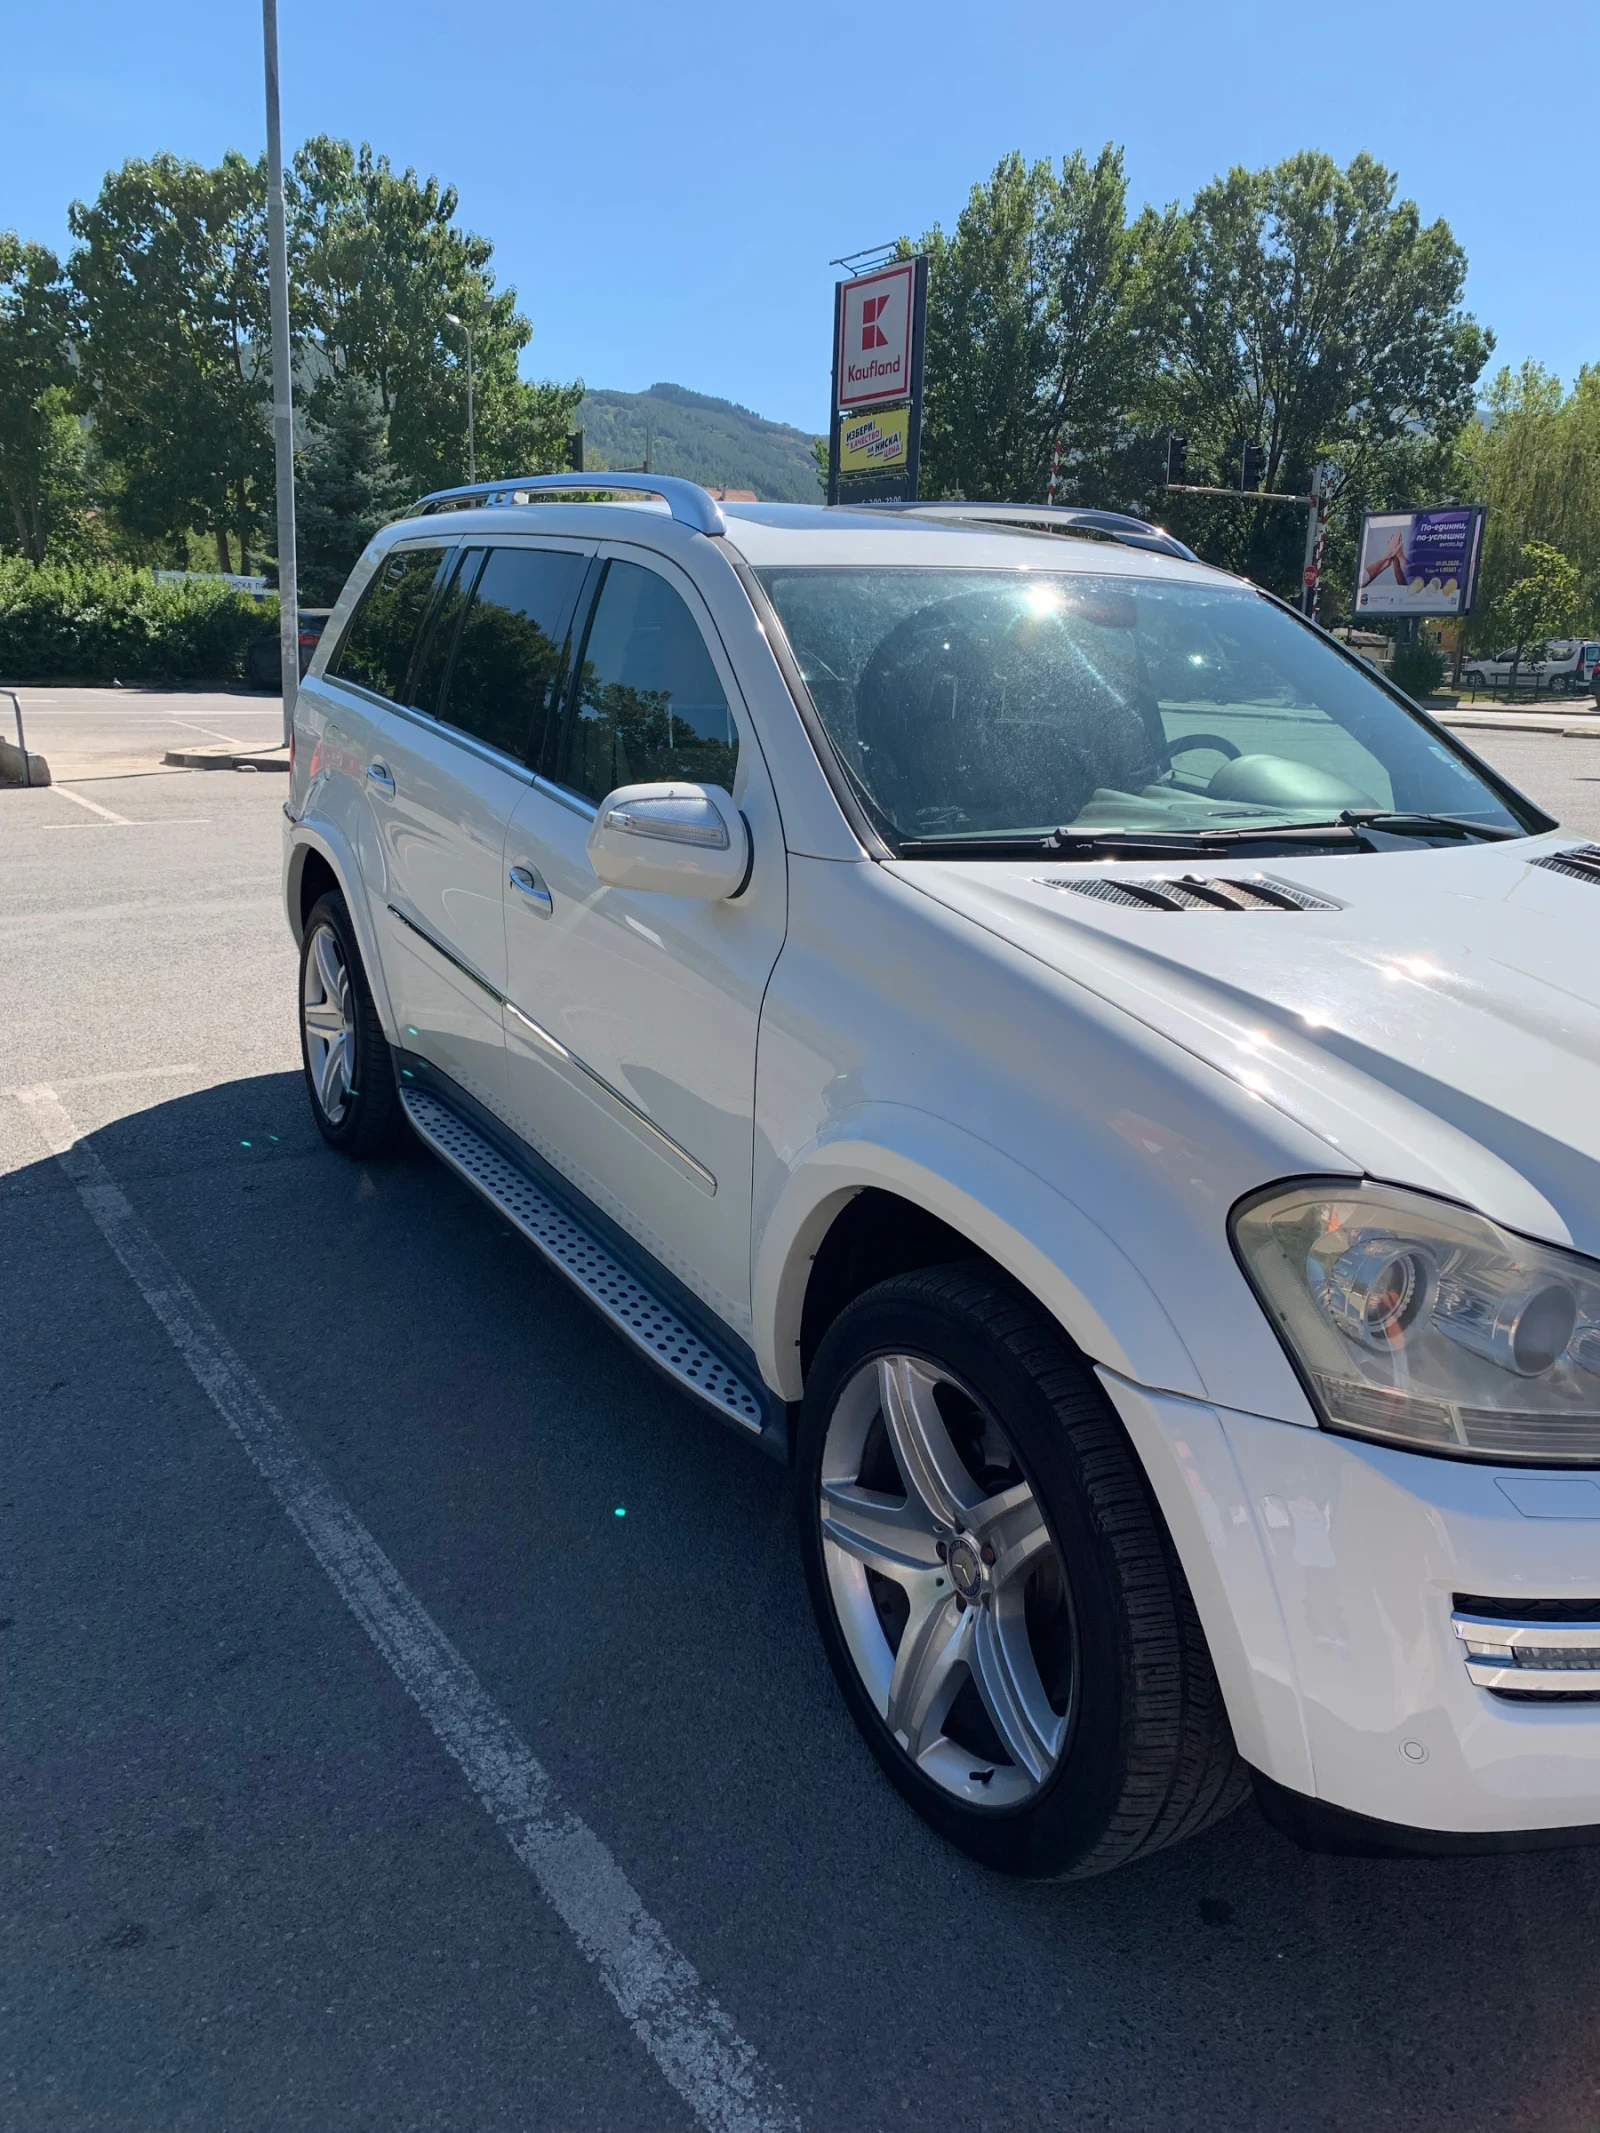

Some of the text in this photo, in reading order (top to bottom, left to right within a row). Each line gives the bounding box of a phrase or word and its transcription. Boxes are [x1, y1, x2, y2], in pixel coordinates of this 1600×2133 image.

[847, 354, 901, 383] Kaufland
[846, 421, 873, 442] ИЗБЕРИ
[849, 429, 880, 449] КАЧЕСТВО
[875, 433, 899, 452] НИСКА
[883, 444, 900, 458] ЦЕНА
[1416, 533, 1466, 542] по-успешни
[1304, 571, 1317, 580] STOP
